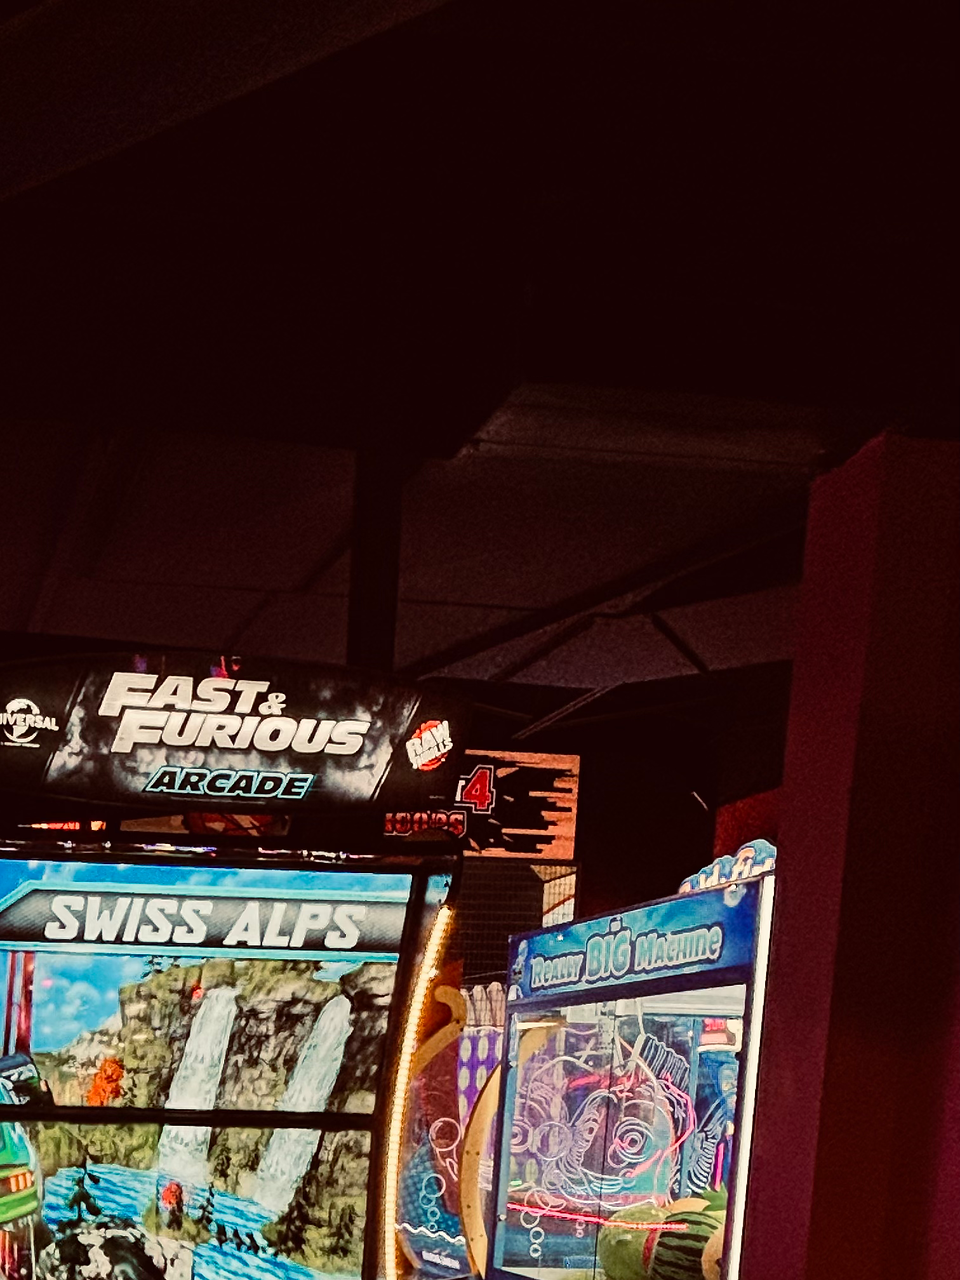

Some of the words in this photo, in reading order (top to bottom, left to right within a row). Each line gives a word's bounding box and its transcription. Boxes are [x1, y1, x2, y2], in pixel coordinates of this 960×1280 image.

[111, 708, 372, 756] FURIOUS
[405, 720, 450, 757] RAW
[145, 765, 315, 800] ARCADE
[461, 768, 493, 810] 4
[44, 895, 214, 944] SWISS
[222, 900, 367, 951] ALPS
[583, 928, 632, 981] BIG
